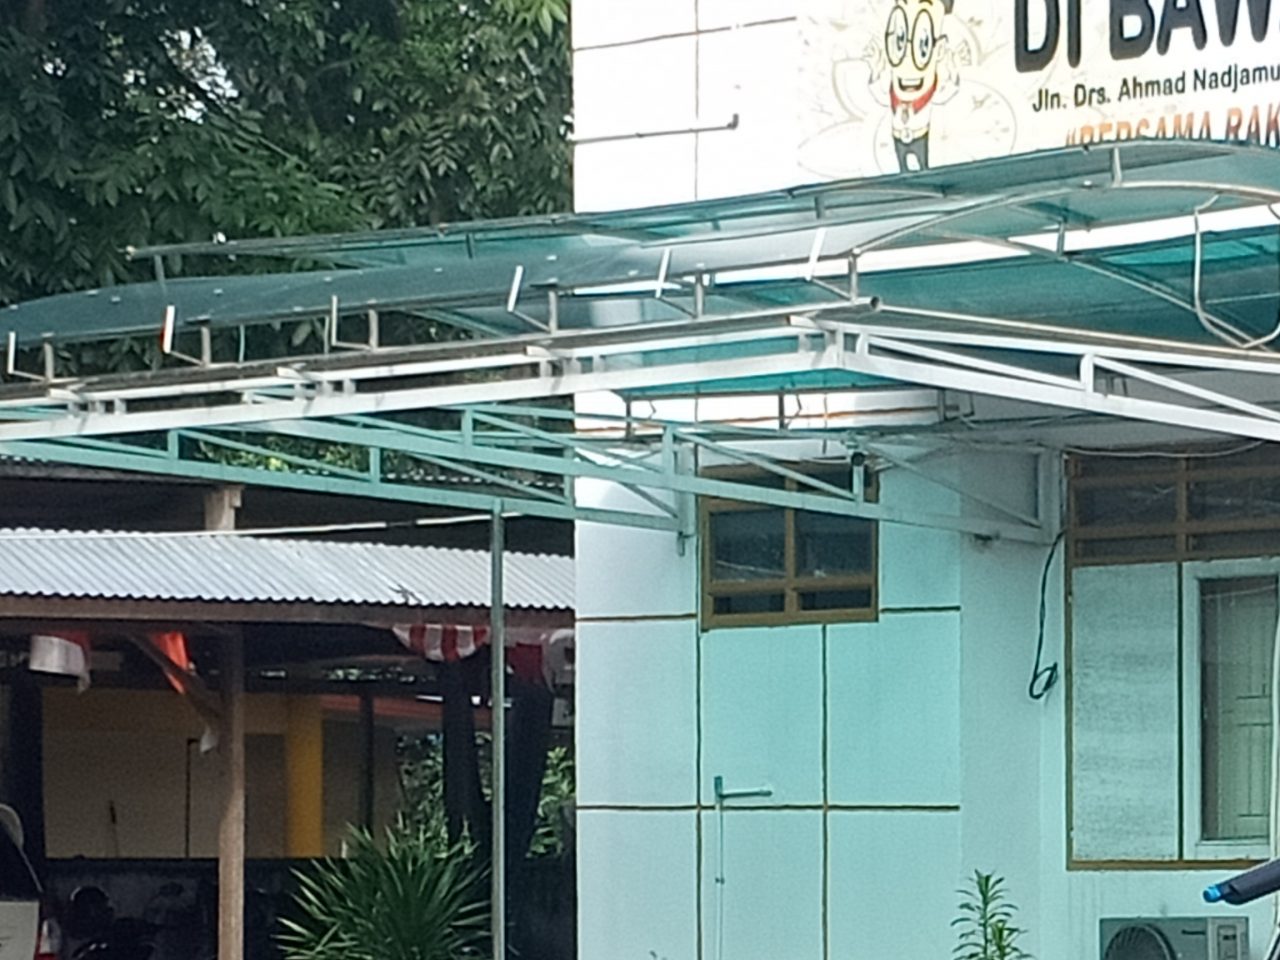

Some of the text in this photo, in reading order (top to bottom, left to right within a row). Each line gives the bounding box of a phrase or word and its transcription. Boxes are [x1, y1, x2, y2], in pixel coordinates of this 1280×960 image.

[1015, 0, 1082, 73] DI
[1033, 87, 1067, 112] Jln.
[1074, 83, 1111, 107] Drs.
[1118, 71, 1185, 101] Ahmad
